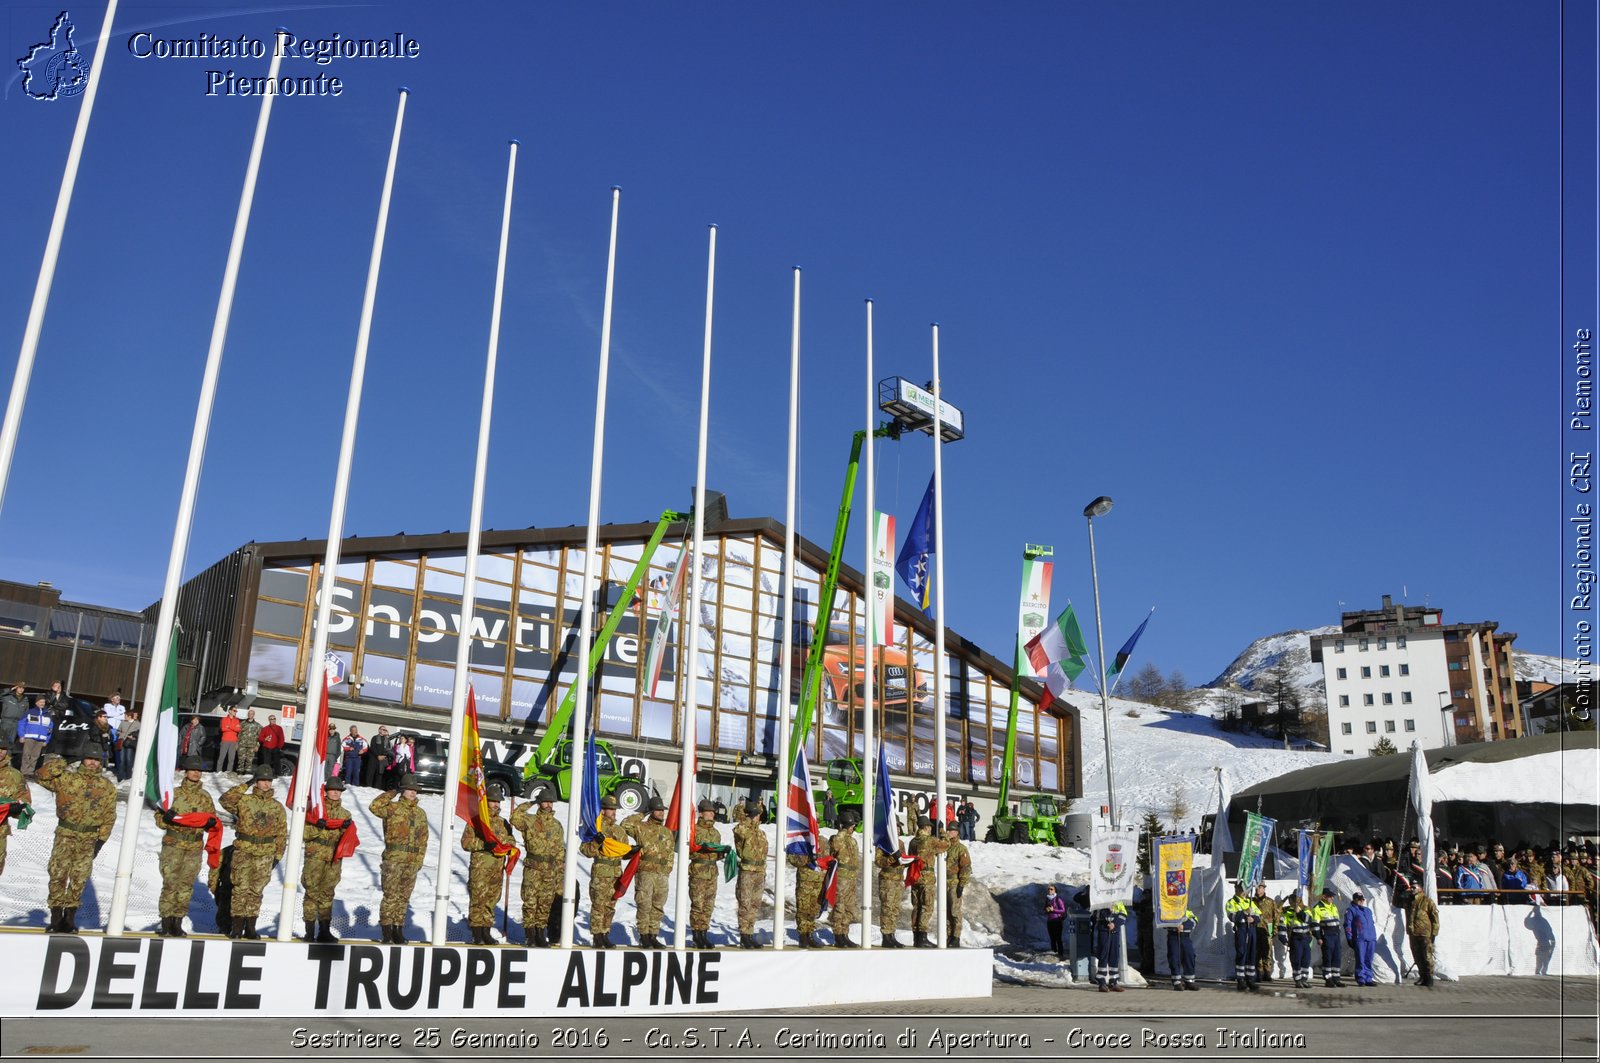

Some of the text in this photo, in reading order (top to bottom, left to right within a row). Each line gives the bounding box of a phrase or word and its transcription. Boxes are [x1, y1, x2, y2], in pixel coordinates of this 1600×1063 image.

[918, 393, 945, 413] MERO
[36, 936, 721, 1010] DELLE TRUPPE ALPINE
